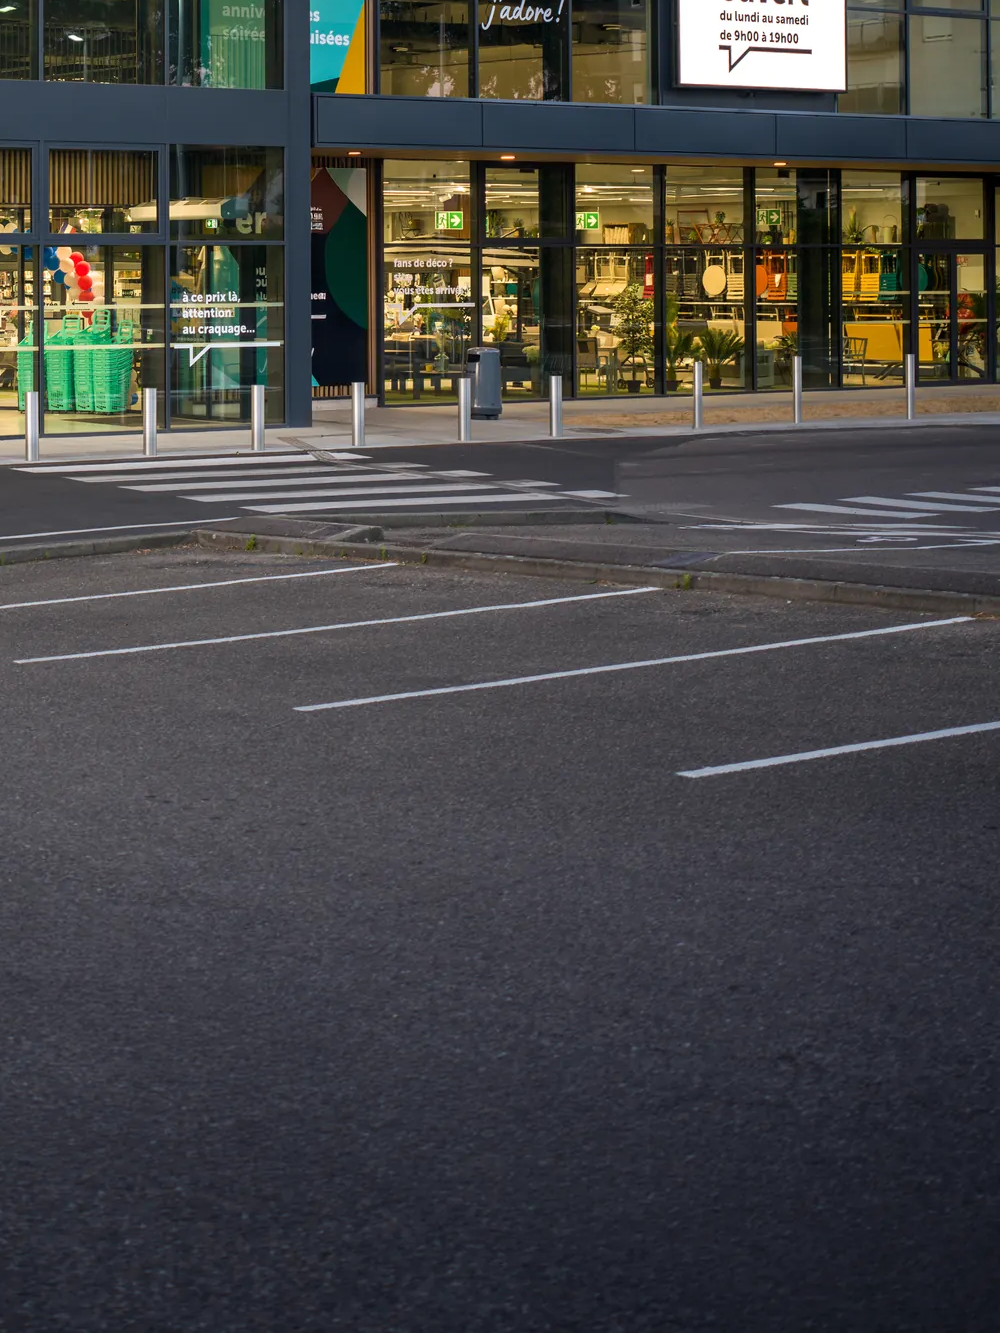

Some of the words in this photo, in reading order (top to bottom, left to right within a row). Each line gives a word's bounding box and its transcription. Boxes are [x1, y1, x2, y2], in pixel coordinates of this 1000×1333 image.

[720, 10, 732, 21] du
[735, 11, 760, 22] lundi
[762, 15, 773, 23] au
[776, 15, 809, 25] samedi
[720, 30, 732, 40] de
[734, 30, 759, 42] 9h00
[762, 32, 767, 42] à
[770, 32, 799, 44] 19h00
[394, 258, 412, 268] fans
[413, 259, 425, 268] de
[426, 258, 448, 268] déco
[393, 287, 415, 295] vous
[182, 292, 189, 303] à
[191, 294, 203, 302] ce
[205, 291, 227, 304] prix
[182, 307, 232, 318] attention
[182, 326, 196, 334] au
[198, 325, 256, 336] craquage...
